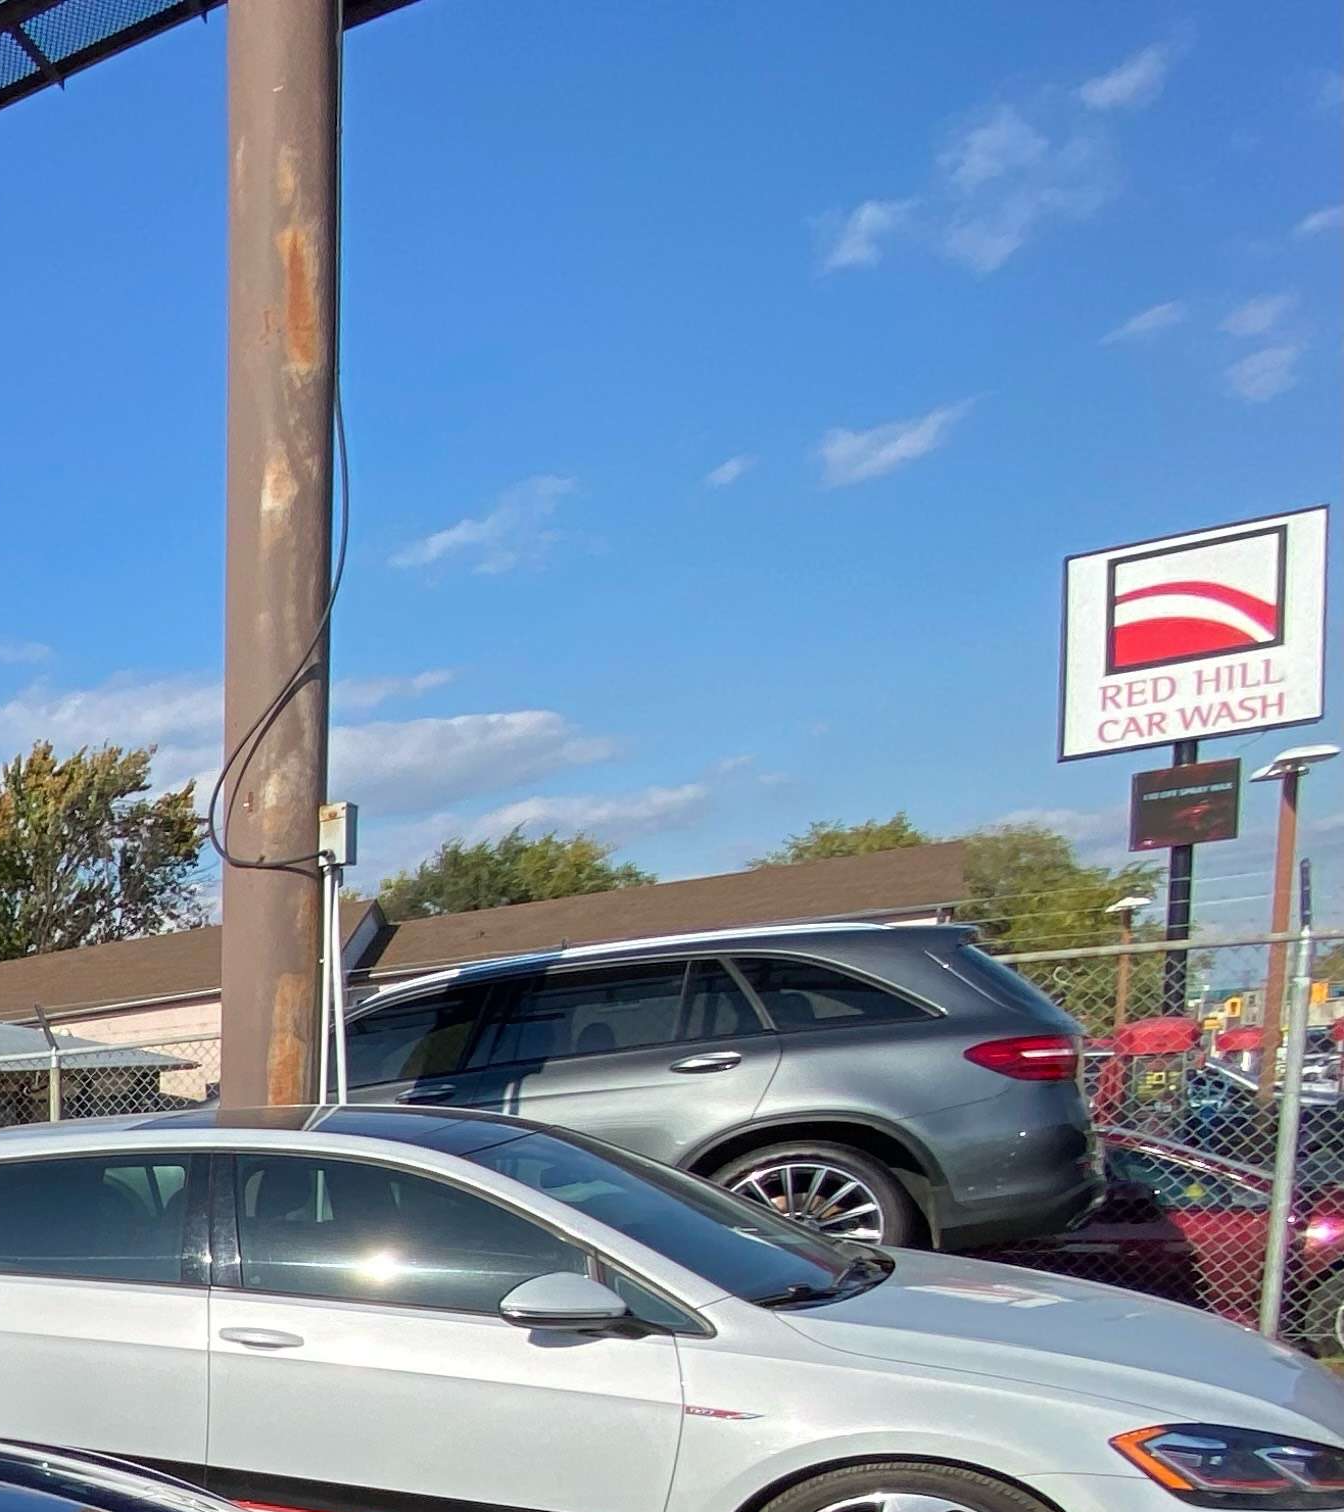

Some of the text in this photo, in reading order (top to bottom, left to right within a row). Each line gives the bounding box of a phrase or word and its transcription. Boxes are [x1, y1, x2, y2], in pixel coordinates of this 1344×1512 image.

[1099, 659, 1286, 712] RED HILL
[1097, 692, 1285, 743] CAR WASH
